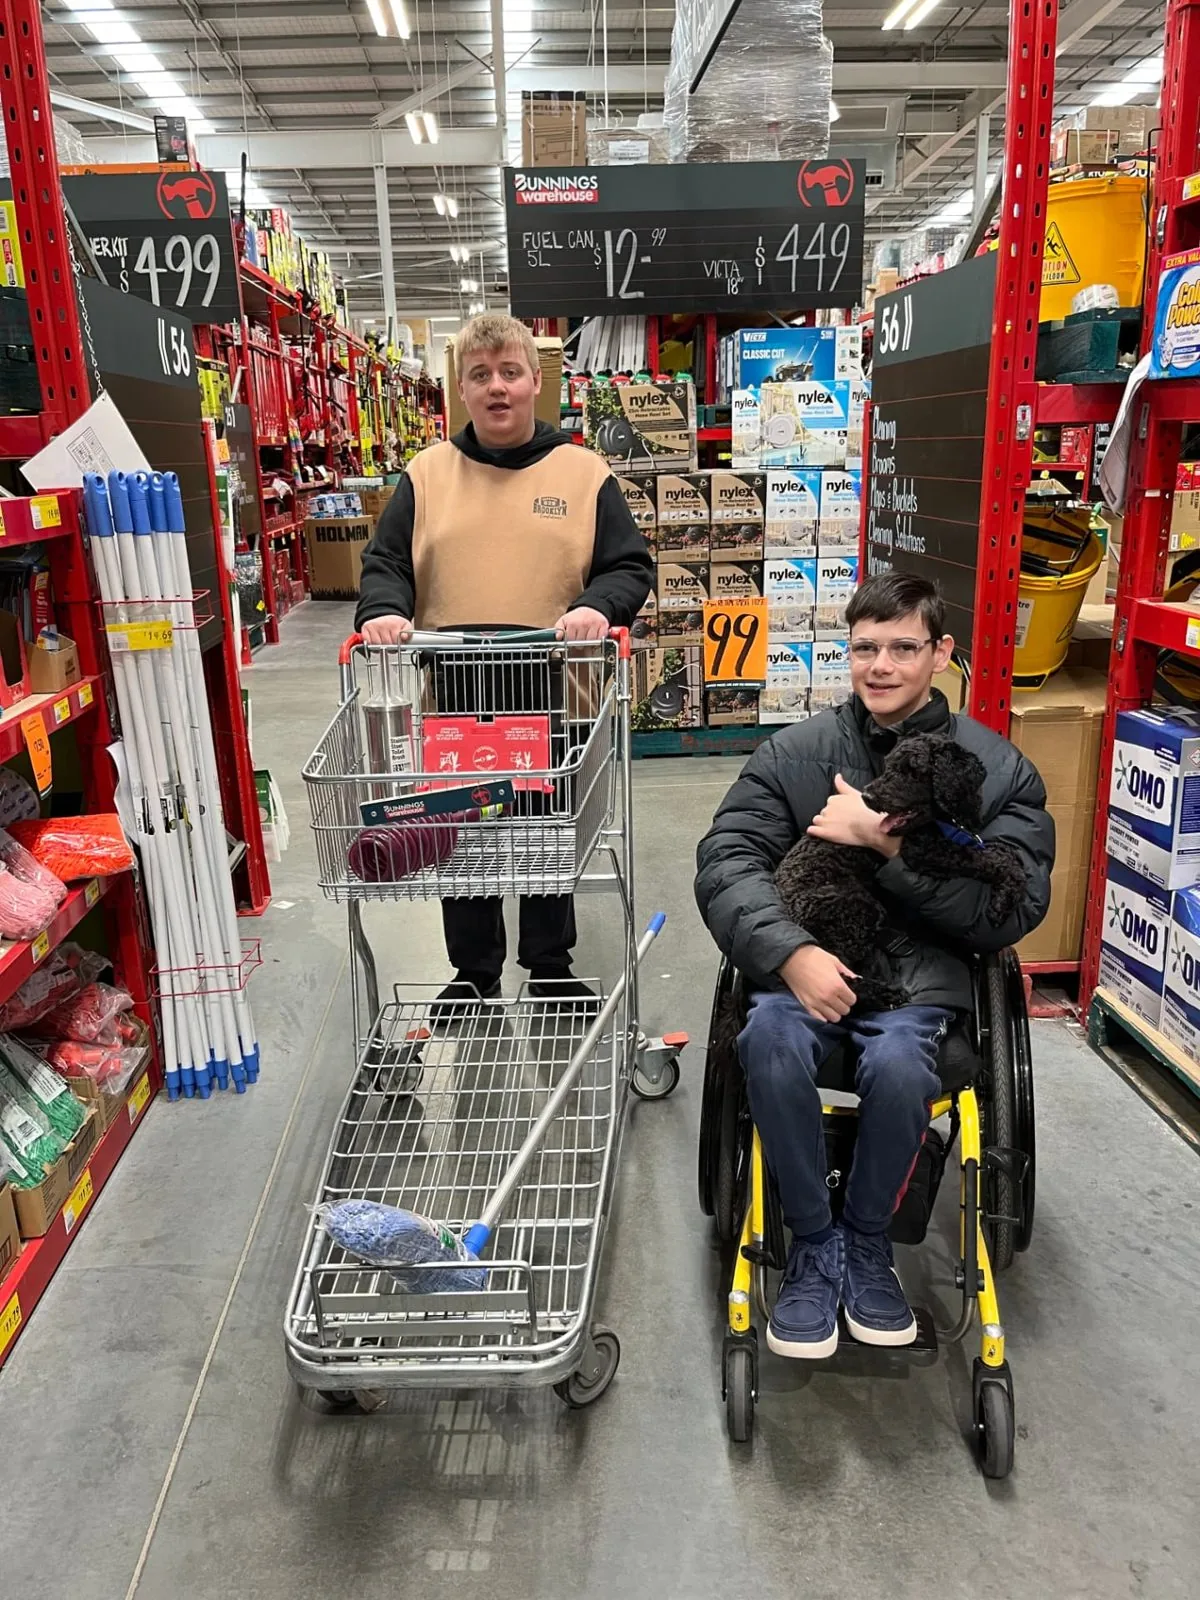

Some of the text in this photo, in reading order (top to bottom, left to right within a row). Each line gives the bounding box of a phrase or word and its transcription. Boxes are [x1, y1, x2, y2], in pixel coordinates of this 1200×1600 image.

[514, 174, 598, 190] BUNNINGS
[522, 187, 594, 202] warehouse
[522, 231, 563, 249] FUEL
[568, 230, 594, 248] CAN
[527, 250, 551, 267] 5L
[1166, 253, 1200, 268] EXTRA VAL
[703, 260, 740, 279] VICTA
[1178, 279, 1200, 306] Col
[1167, 302, 1200, 330] Powe
[880, 303, 899, 354] 56
[170, 326, 190, 376] 56
[743, 349, 785, 360] CLASSIC CUT
[630, 392, 670, 408] nylex
[734, 398, 758, 410] nylex
[798, 390, 834, 406] nylex
[872, 442, 896, 474] Brooms
[623, 488, 646, 500] lex
[666, 488, 700, 500] nylex
[720, 486, 754, 499] nylex
[772, 480, 806, 493] nylex
[826, 480, 853, 492] nyle
[892, 478, 918, 512] Buckets
[532, 502, 568, 516] BROOKLYN
[316, 524, 369, 542] HOLMAN
[896, 514, 926, 554] Solutions
[666, 576, 700, 586] nylex
[718, 574, 750, 585] nylex
[769, 568, 804, 581] nylex
[707, 613, 759, 678] 99
[767, 652, 799, 664] nylex
[817, 650, 846, 662] nyle
[1130, 766, 1165, 810] OMO
[383, 801, 424, 813] BUNNINGS
[1110, 824, 1139, 846] LAUNDRY POWDER
[1122, 908, 1158, 955] OMO
[1117, 968, 1132, 984] POWDER
